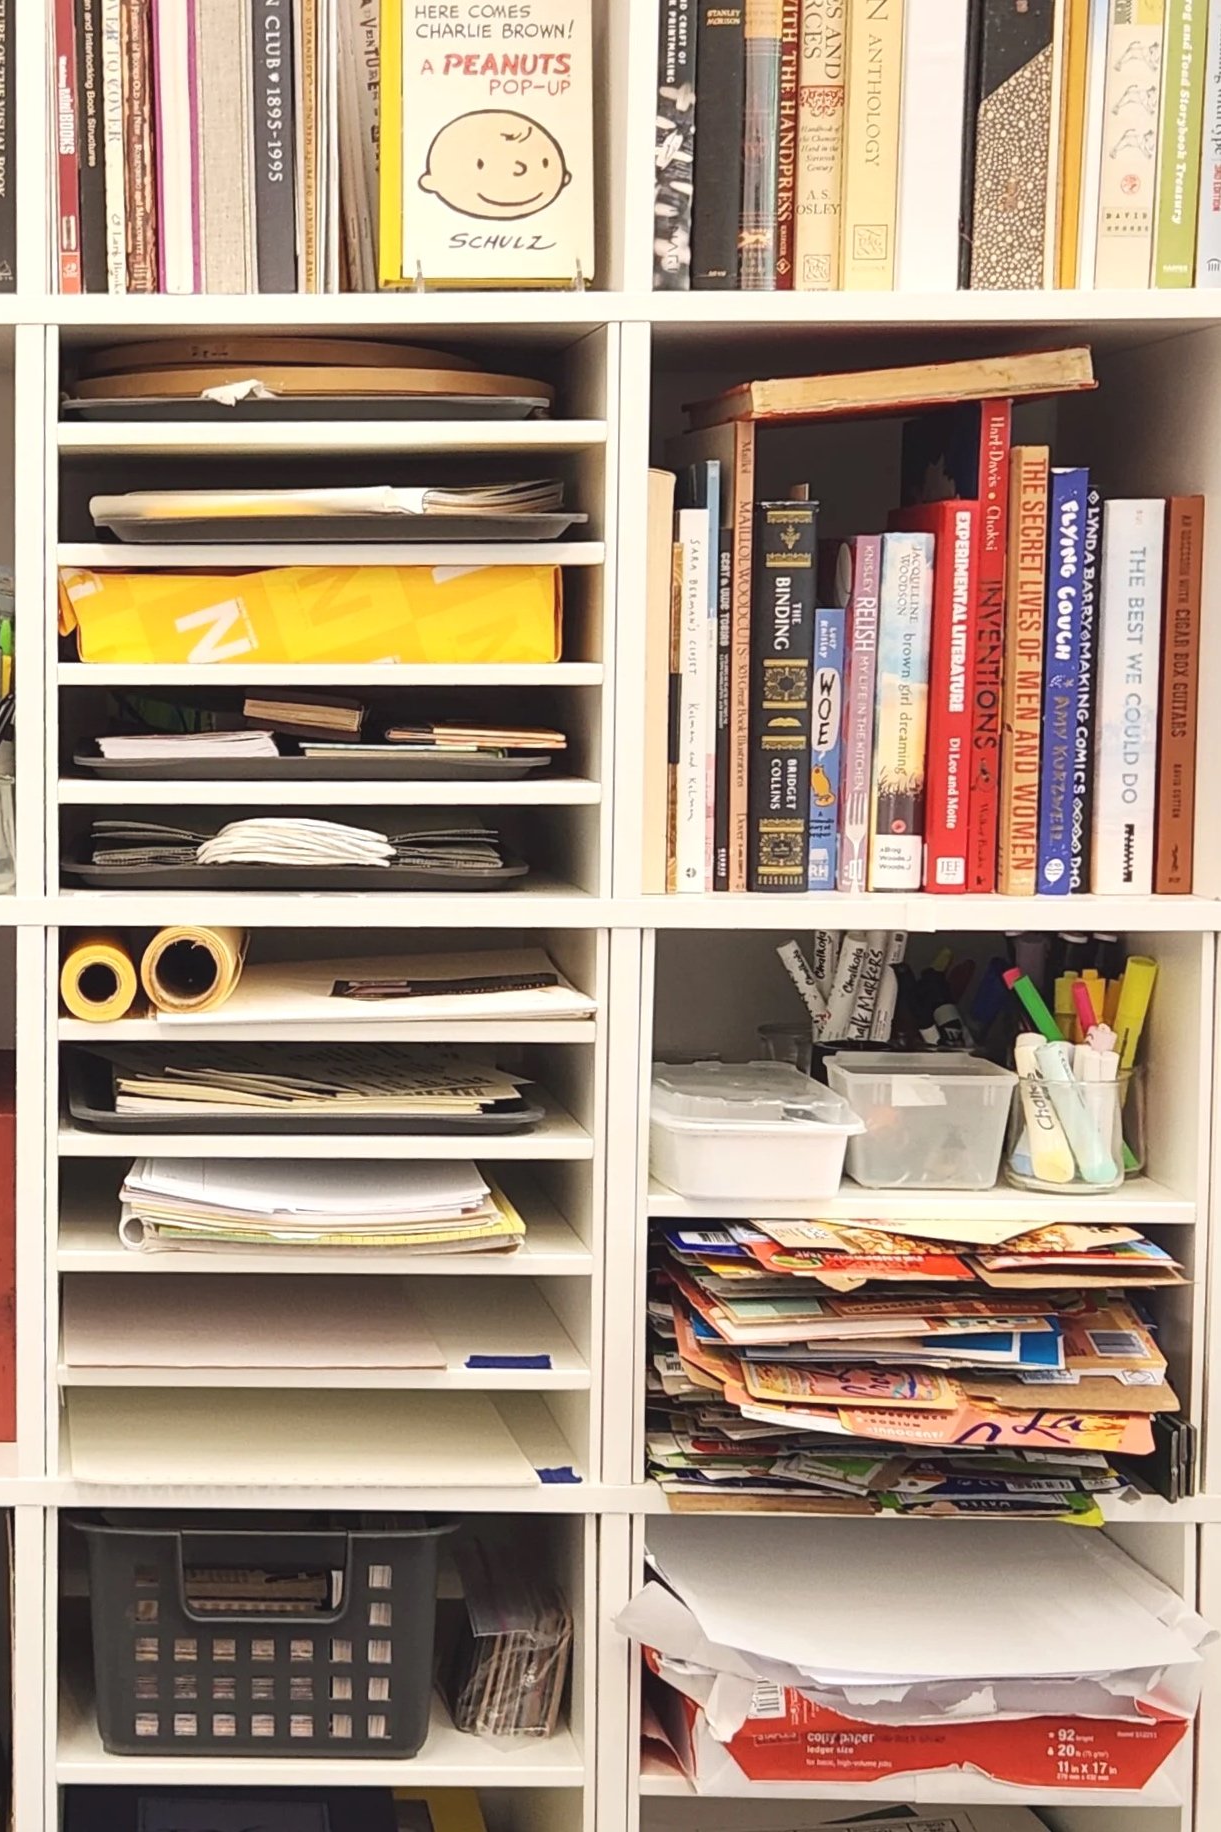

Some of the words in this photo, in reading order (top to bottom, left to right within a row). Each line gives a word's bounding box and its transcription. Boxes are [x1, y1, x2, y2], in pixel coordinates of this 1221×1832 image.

[85, 12, 93, 31] and
[415, 5, 459, 19] HERE
[468, 5, 531, 19] COMES
[416, 23, 492, 39] CHARLIE
[502, 20, 574, 39] BROWN!
[678, 15, 687, 47] CRAFT
[265, 15, 281, 70] CLUB
[666, 11, 677, 84] PRINTMAKING
[678, 51, 687, 65] OF
[825, 26, 843, 80] AND
[1182, 24, 1193, 50] and
[85, 33, 95, 89] Interlocking
[106, 51, 119, 73] TO
[420, 59, 434, 75] A
[442, 53, 572, 77] PEANUTS
[780, 51, 797, 94] THE
[1180, 53, 1192, 87] Toad
[87, 90, 95, 116] Book
[488, 79, 571, 96] POP-UP
[865, 34, 882, 167] ANTHOLOGY
[107, 78, 121, 143] COVER
[1176, 90, 1190, 158] Storybook
[60, 114, 75, 155] BOOKS
[88, 118, 97, 167] Structures
[266, 87, 283, 183] 1895-1995
[777, 100, 796, 222] HANDPRESS
[1171, 163, 1188, 224] Treasury
[447, 232, 558, 251] SCHULZ
[986, 416, 1004, 488] Hart-Davis
[1022, 458, 1047, 495] THE
[738, 500, 753, 562] MAILLOL
[984, 505, 1001, 552] Choksi
[1019, 500, 1046, 575] SECRET
[1059, 499, 1080, 578] FLYING
[1084, 507, 1100, 564] LYNDA
[689, 539, 701, 570] SARA
[862, 545, 875, 593] KNISLEY
[952, 511, 971, 623] EXPERIMENTAL
[1129, 546, 1147, 588] THE
[688, 579, 701, 631] BERMAN'S
[896, 554, 910, 617] WOODSON
[908, 545, 923, 625] JACQUELINE
[1018, 580, 1044, 632] LIVES
[1081, 566, 1095, 631] BARRY
[1178, 579, 1190, 604] WITH
[773, 576, 792, 651] BINDING
[791, 602, 802, 625] THE
[854, 597, 877, 651] RELISH
[1054, 586, 1077, 660] COUCH
[1126, 597, 1145, 645] BEST
[1173, 608, 1190, 648] CIGAR
[688, 640, 699, 676] CLOSET
[859, 655, 870, 673] MY
[901, 633, 916, 678] brown
[948, 624, 967, 713] LITERATURE
[973, 580, 1003, 750] INVENTIONS
[1017, 638, 1042, 663] OF
[1125, 653, 1144, 685] WE
[1172, 652, 1189, 678] BOX
[858, 676, 868, 700] LIFE
[897, 684, 913, 706] girl
[1015, 671, 1040, 721] MEN
[1076, 642, 1091, 723] MAKING
[736, 709, 747, 732] Book
[816, 673, 836, 747] WOE
[856, 717, 867, 740] THE
[857, 702, 868, 714] IN
[1052, 695, 1071, 740] AMY
[1123, 693, 1142, 766] COULD
[1170, 683, 1188, 738] GUITARS
[736, 735, 747, 788] Illustrations
[854, 741, 866, 791] KITCHEN
[895, 712, 912, 776] dreaming
[948, 754, 959, 773] Leo
[949, 737, 960, 752] Di
[1013, 729, 1038, 774] AND
[1073, 726, 1090, 794] COMICS
[769, 758, 784, 810] COLLINS
[785, 758, 798, 810] BRIDGET
[947, 775, 959, 795] and
[1121, 773, 1138, 804] DO
[735, 813, 747, 841] Dover
[946, 797, 959, 830] Motte
[1011, 783, 1037, 871] WOMEN
[1012, 1408, 1086, 1444] La
[806, 1732, 837, 1745] copy
[839, 1733, 875, 1745] paper
[806, 1746, 834, 1755] ledger
[836, 1746, 854, 1754] size
[1057, 1728, 1076, 1741] 92
[1057, 1744, 1076, 1757] 20
[1057, 1761, 1070, 1774] 11
[1092, 1762, 1108, 1774] 17
